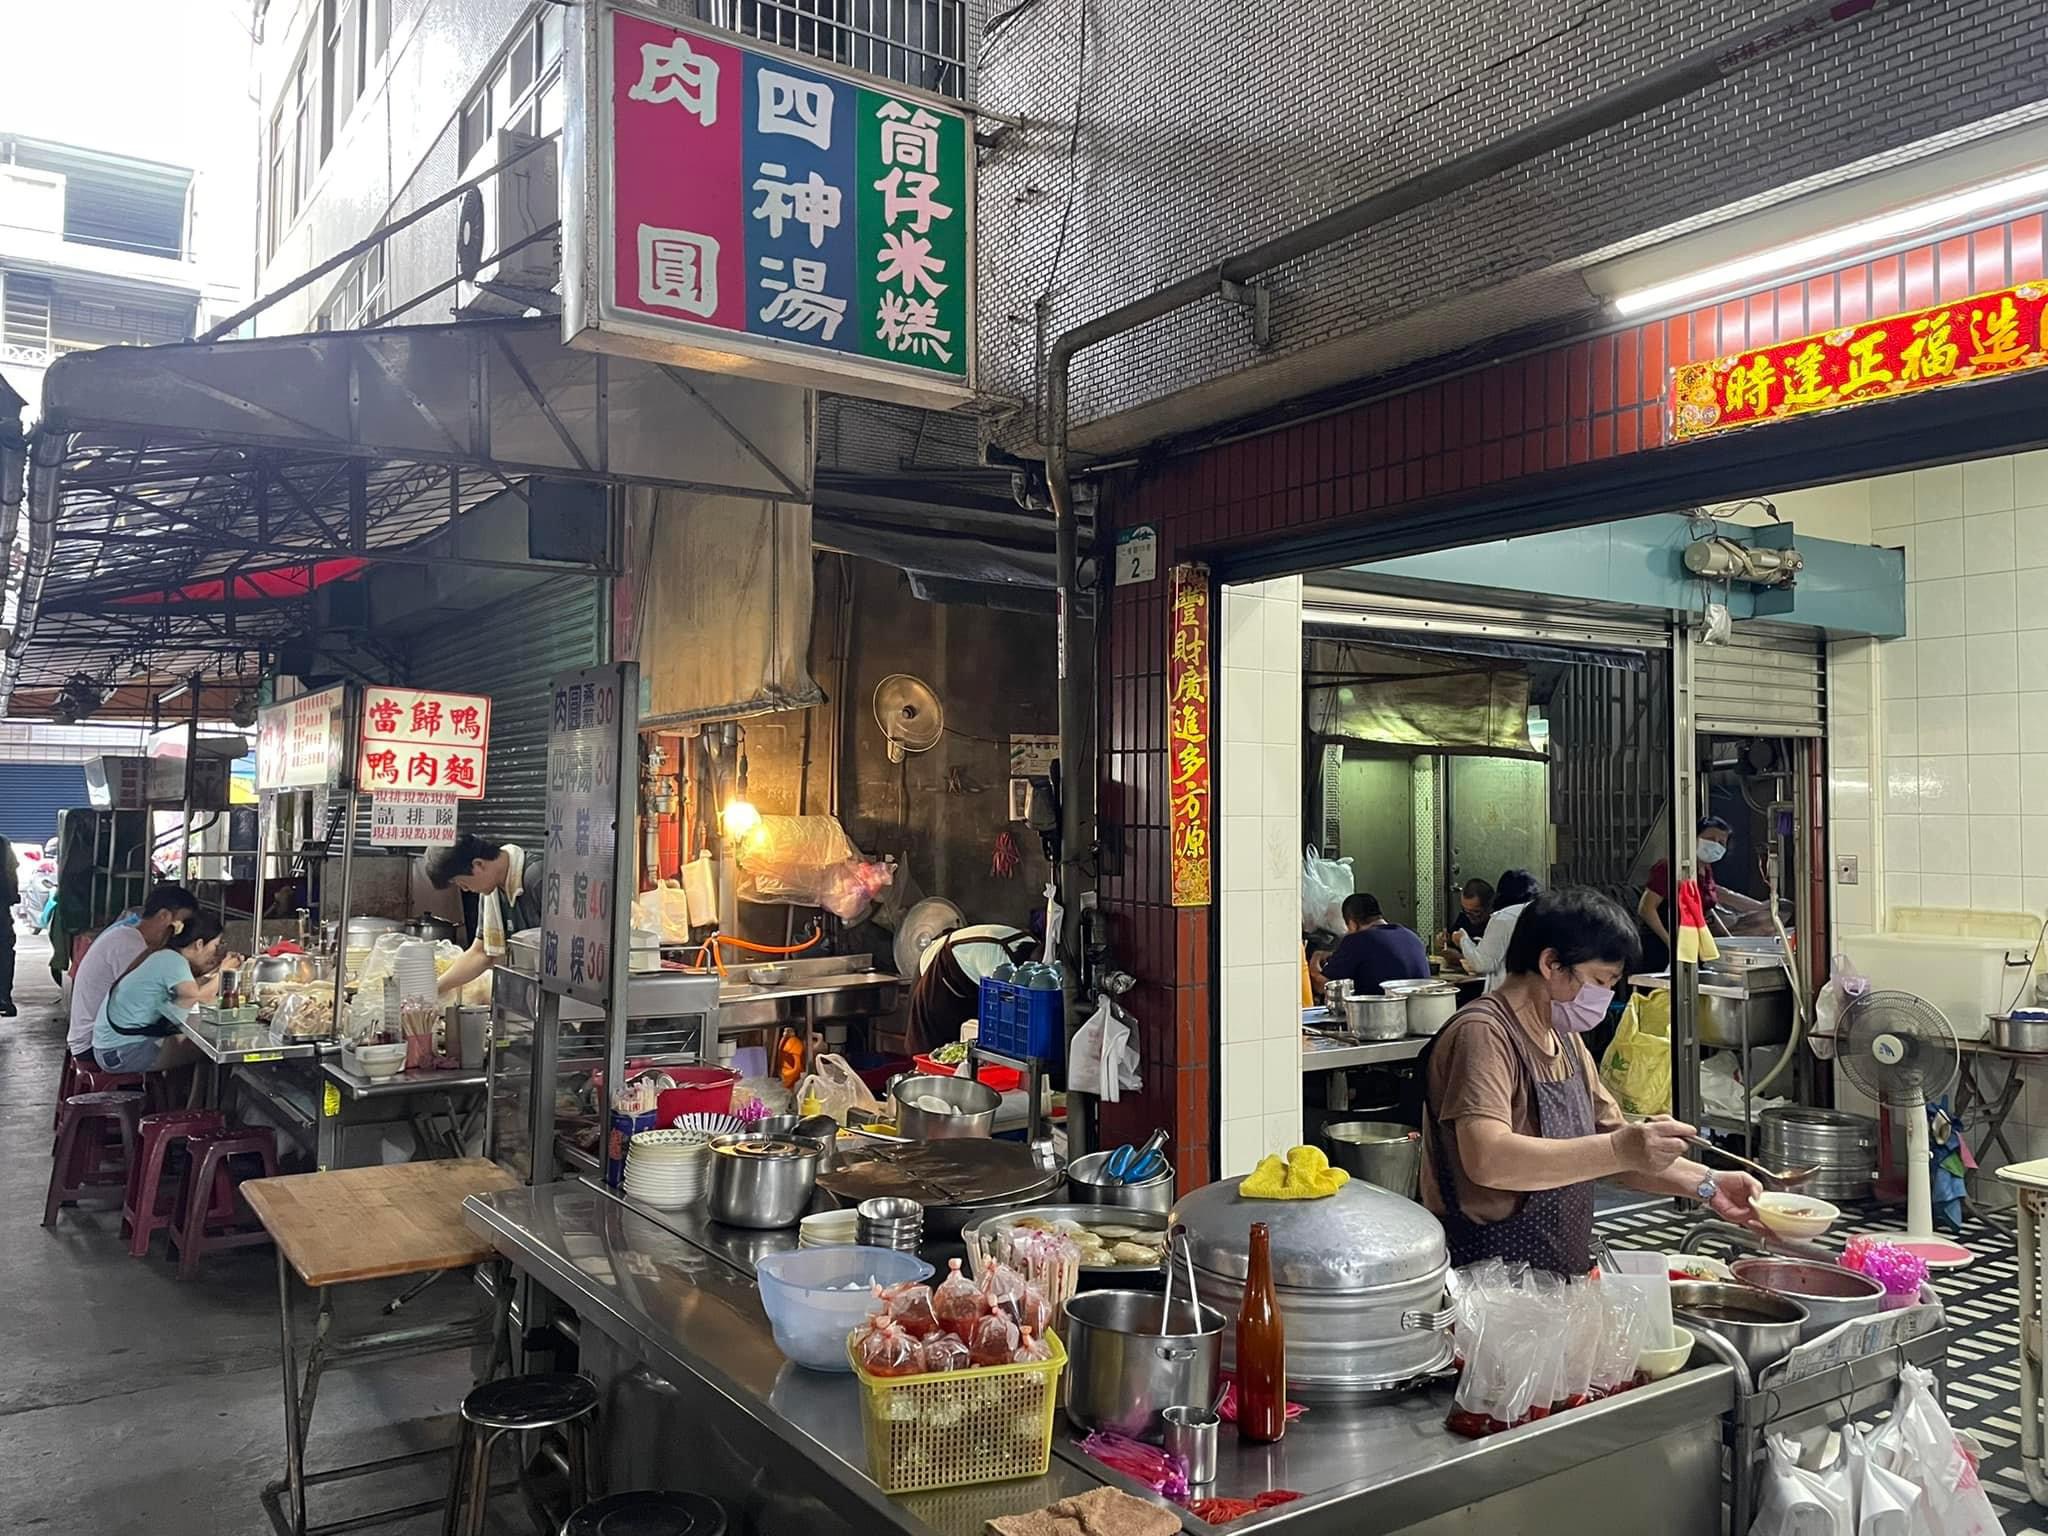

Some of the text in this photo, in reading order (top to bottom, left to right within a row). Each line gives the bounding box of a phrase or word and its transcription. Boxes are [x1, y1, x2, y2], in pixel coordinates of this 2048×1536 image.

[629, 37, 720, 319] 肉圓
[752, 67, 847, 342] 四神湯
[873, 100, 953, 364] 筒仔米糕
[1131, 557, 1140, 579] 2
[369, 697, 481, 740] 當歸鴨
[597, 687, 614, 725] 30
[366, 749, 479, 789] 鴨肉麵
[377, 807, 453, 825] 請排隊
[589, 880, 608, 920] 40
[587, 941, 605, 982] 30
